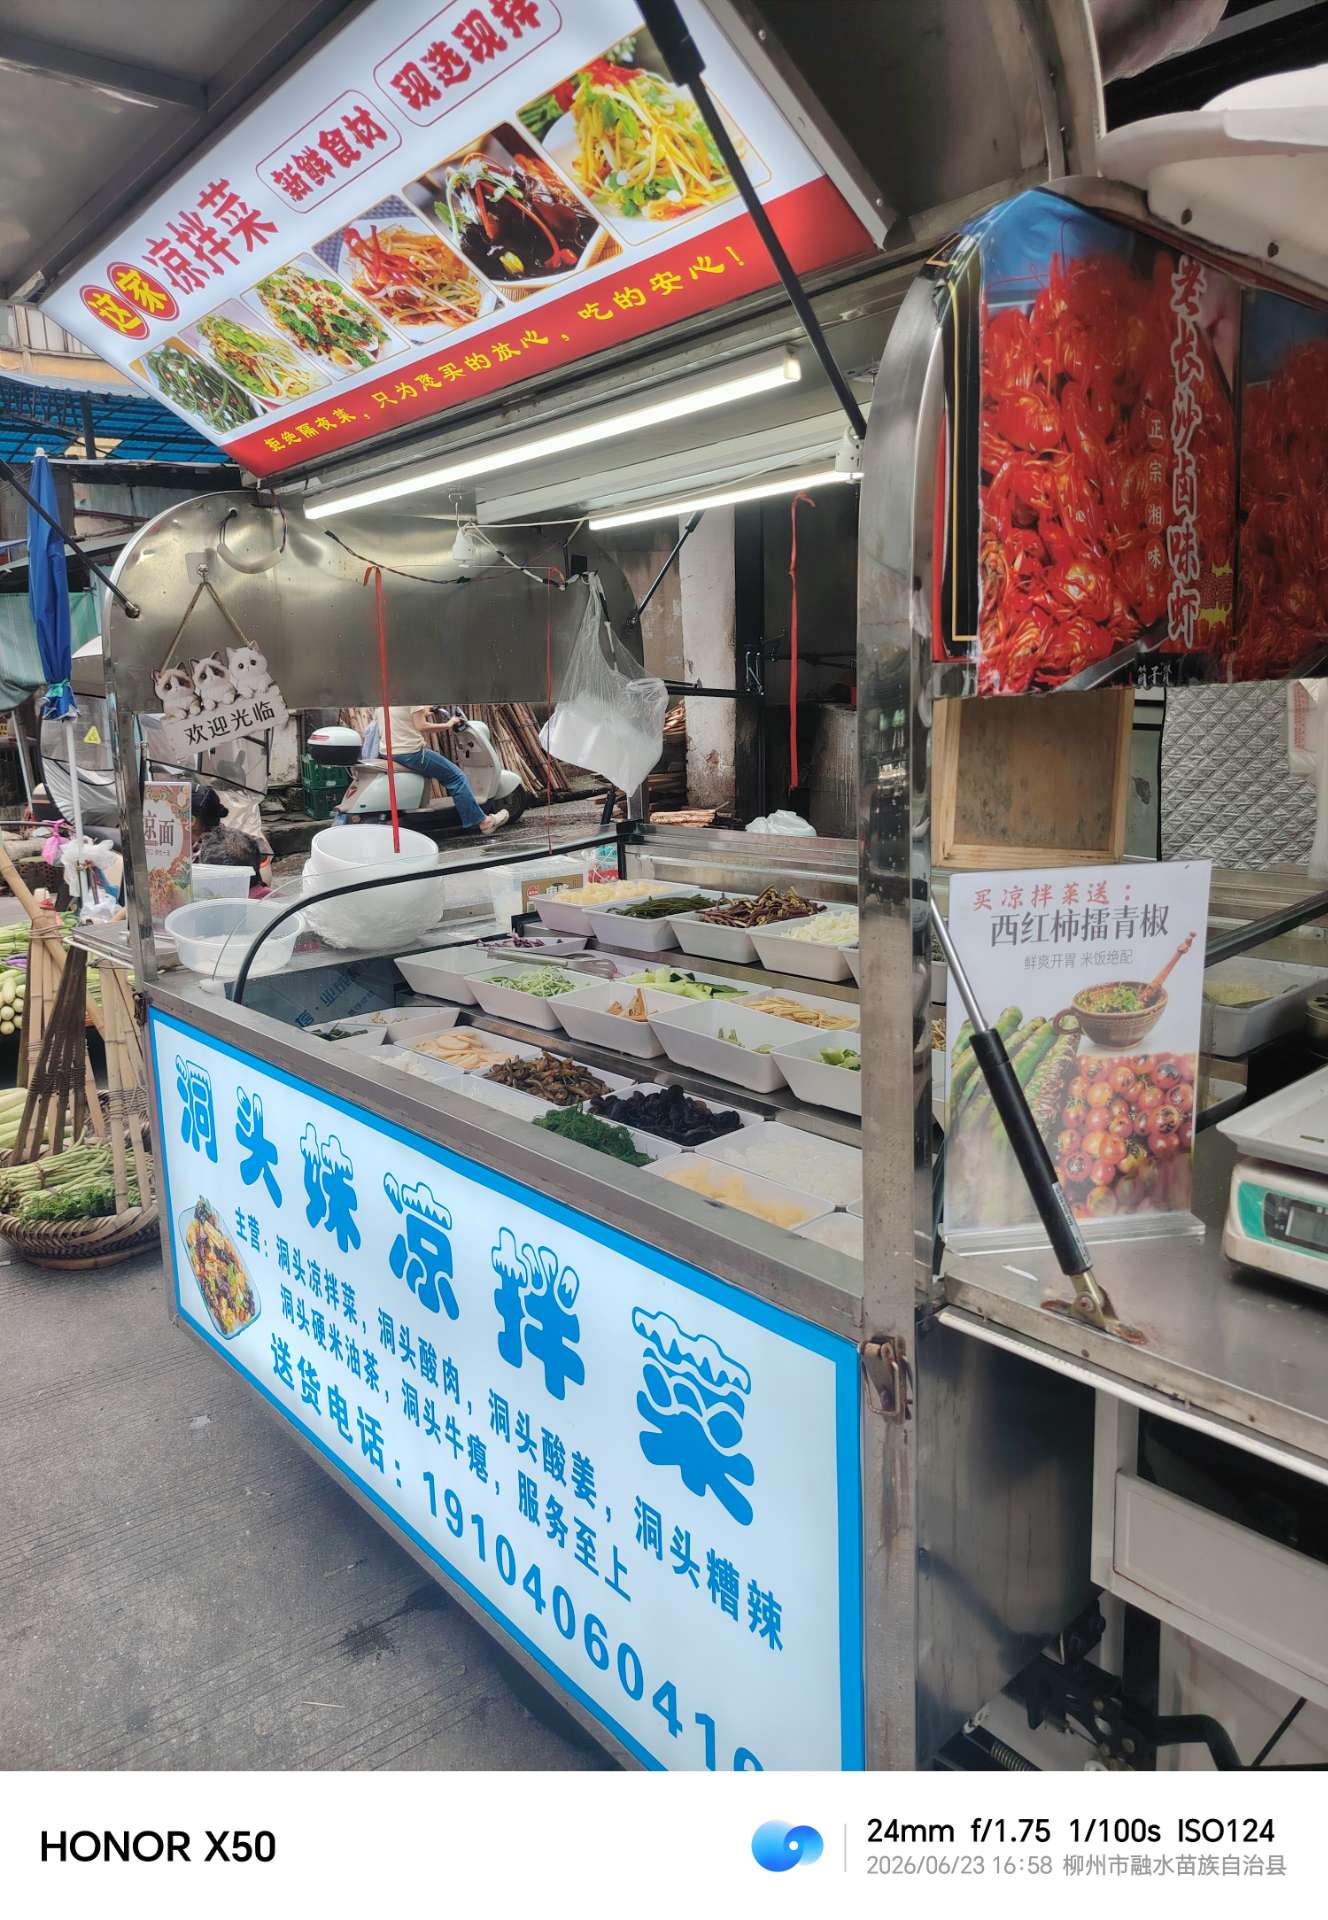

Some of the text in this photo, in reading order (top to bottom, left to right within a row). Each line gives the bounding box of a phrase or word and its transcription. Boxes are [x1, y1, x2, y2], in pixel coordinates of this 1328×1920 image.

[270, 105, 388, 202] 新鲜食材
[1148, 418, 1164, 568] 正宗湘味
[184, 701, 275, 745] 欢迎光临
[990, 903, 1169, 947] 西红柿擂青椒
[1024, 949, 1134, 970] 鲜爽开胃 米饭绝配
[175, 1054, 755, 1526] 洞头妹凉拌菜
